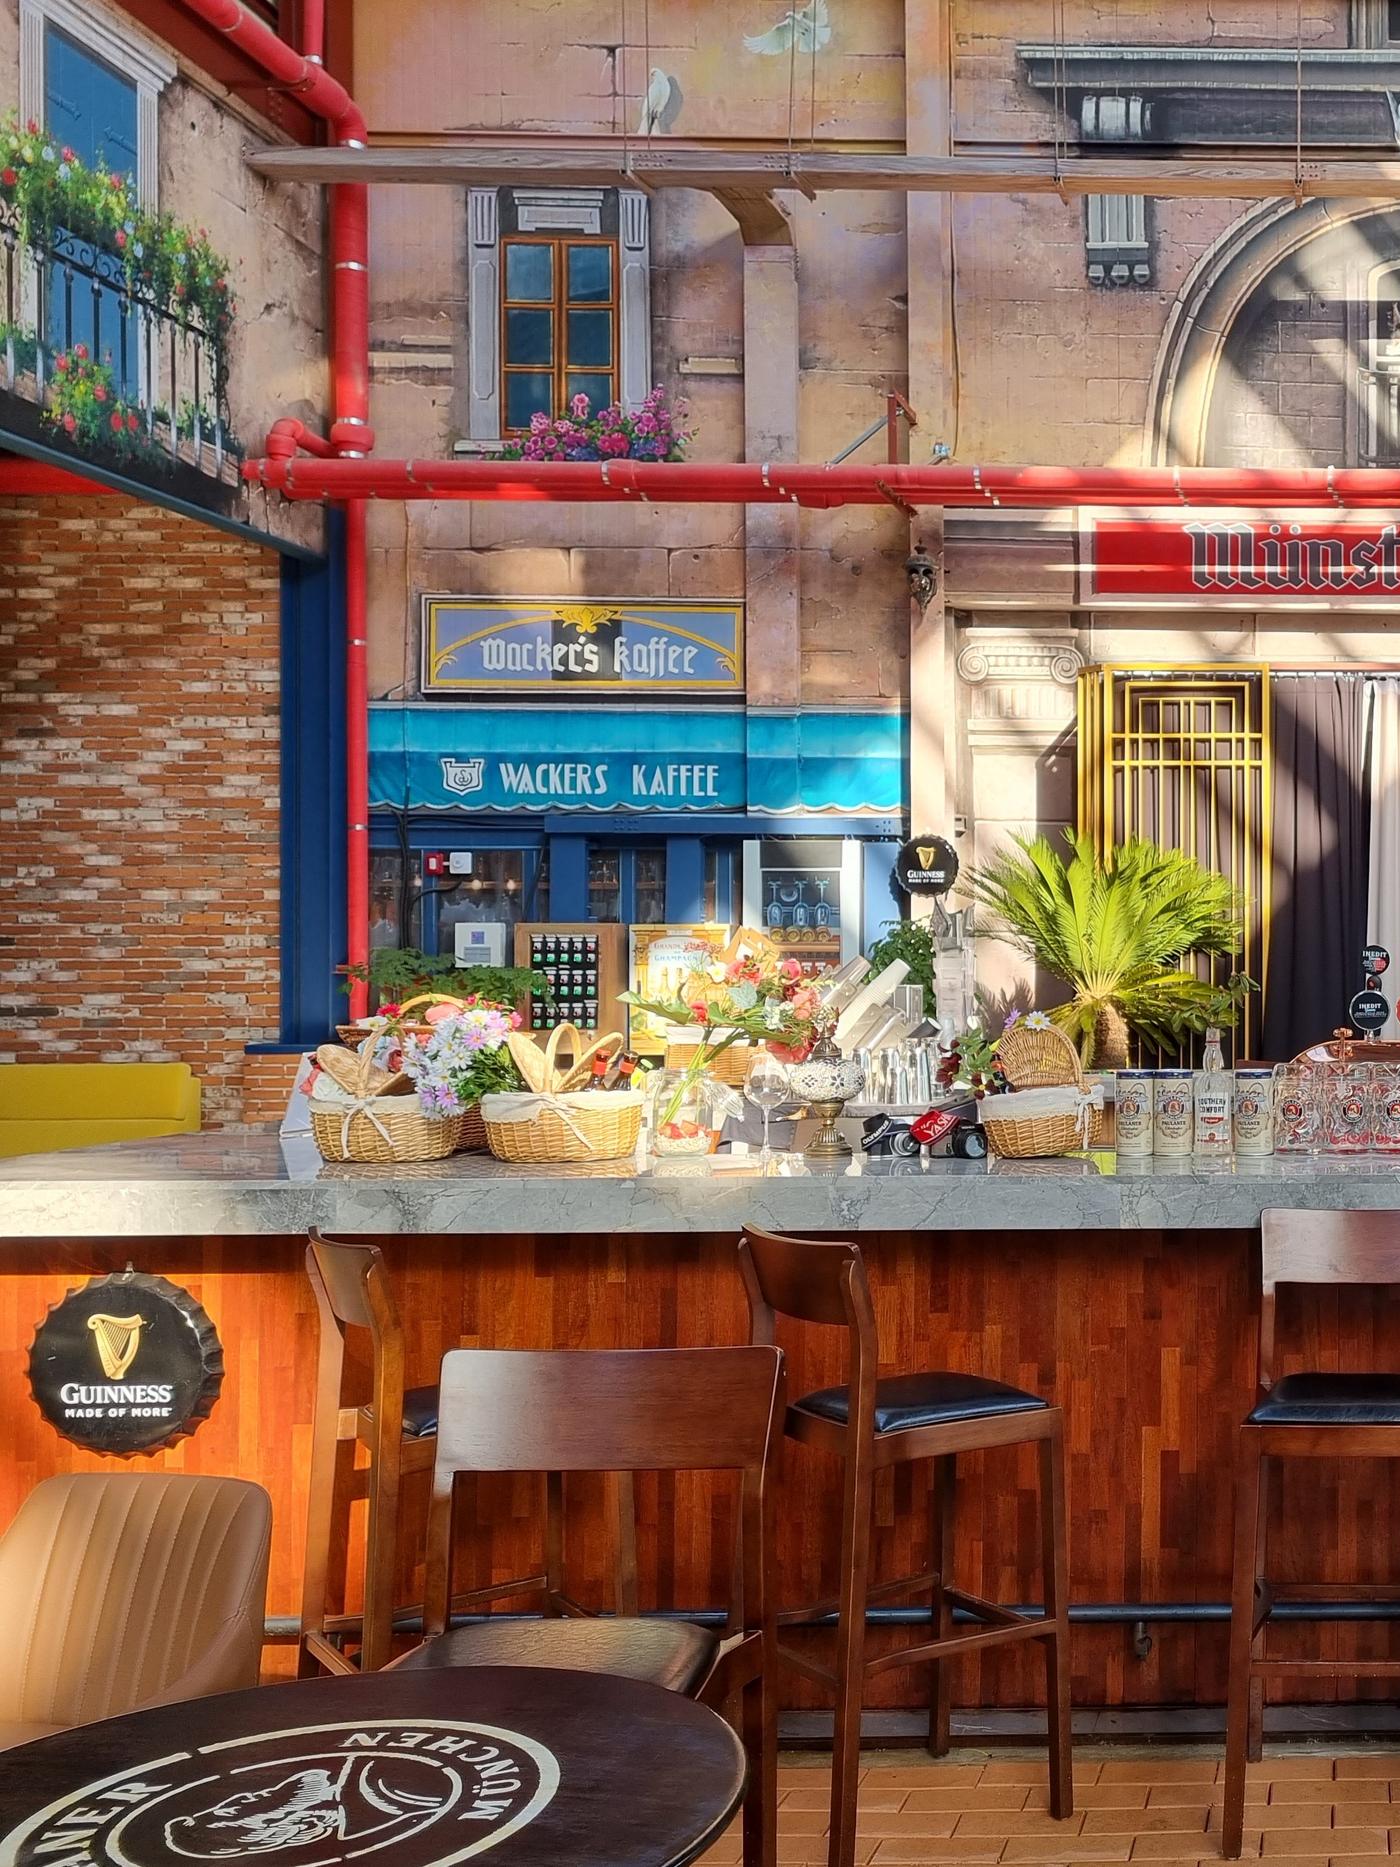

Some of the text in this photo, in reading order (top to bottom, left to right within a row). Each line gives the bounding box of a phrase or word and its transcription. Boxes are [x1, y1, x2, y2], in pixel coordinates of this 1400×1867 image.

[499, 762, 719, 797] WACKERS KAFFEE
[907, 870, 945, 878] GUINNESS
[1362, 950, 1387, 958] INEDIT
[862, 1120, 889, 1145] OLYMPUS
[60, 1382, 172, 1405] GUINNESS
[64, 1407, 171, 1418] MADE OF MORE
[338, 1732, 522, 1821] MÜNCHEN
